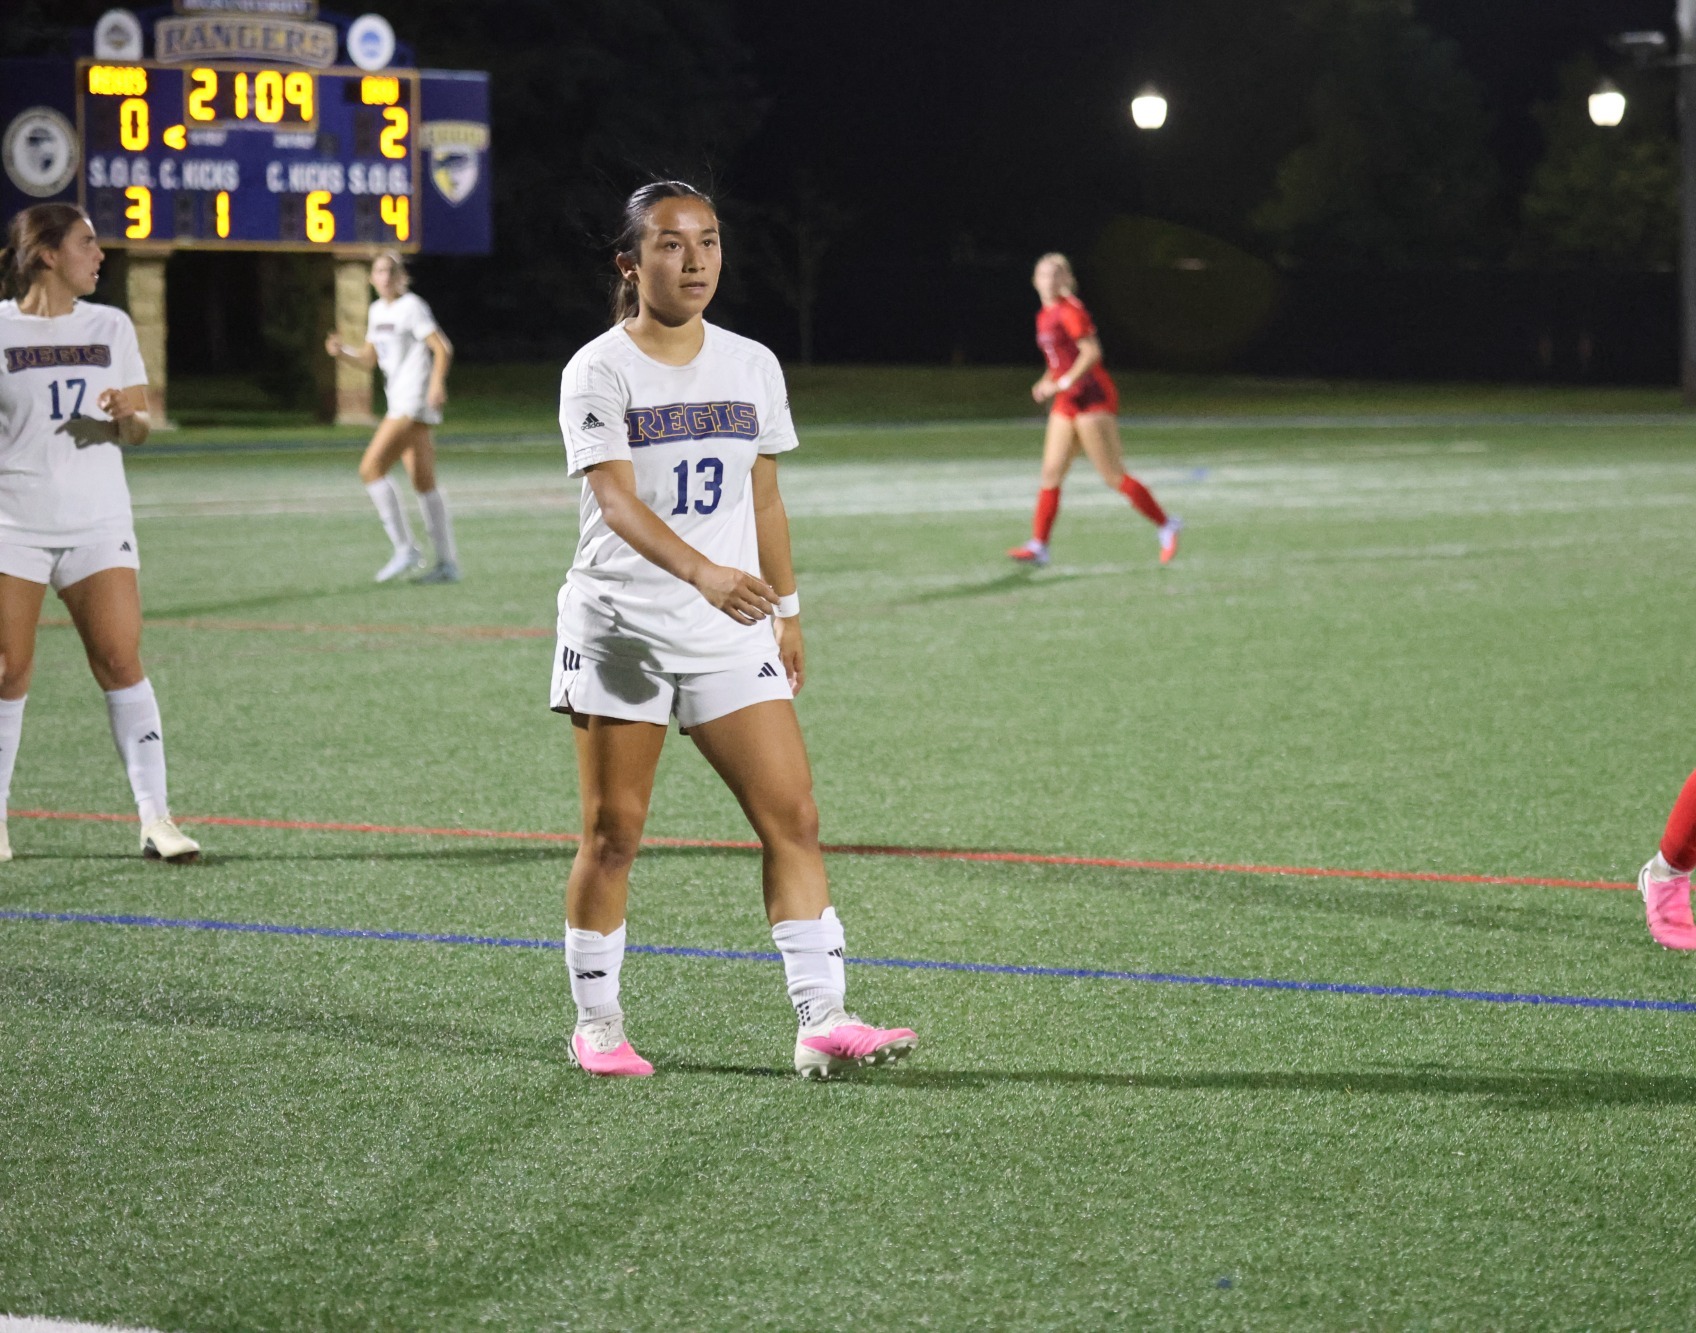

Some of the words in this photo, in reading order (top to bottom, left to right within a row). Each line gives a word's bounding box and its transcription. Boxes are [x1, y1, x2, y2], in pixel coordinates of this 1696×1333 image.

[158, 20, 335, 63] RANGERS
[120, 98, 150, 151] 0
[380, 106, 409, 159] 2
[182, 159, 240, 192] KICKS
[288, 161, 345, 195] KICKS
[125, 185, 151, 239] 3
[216, 191, 230, 238] 1
[306, 190, 335, 243] 6
[380, 194, 409, 242] 4
[4, 344, 112, 374] REGIS
[48, 378, 87, 420] 17
[624, 401, 760, 448] REGIS
[671, 457, 724, 516] 13
